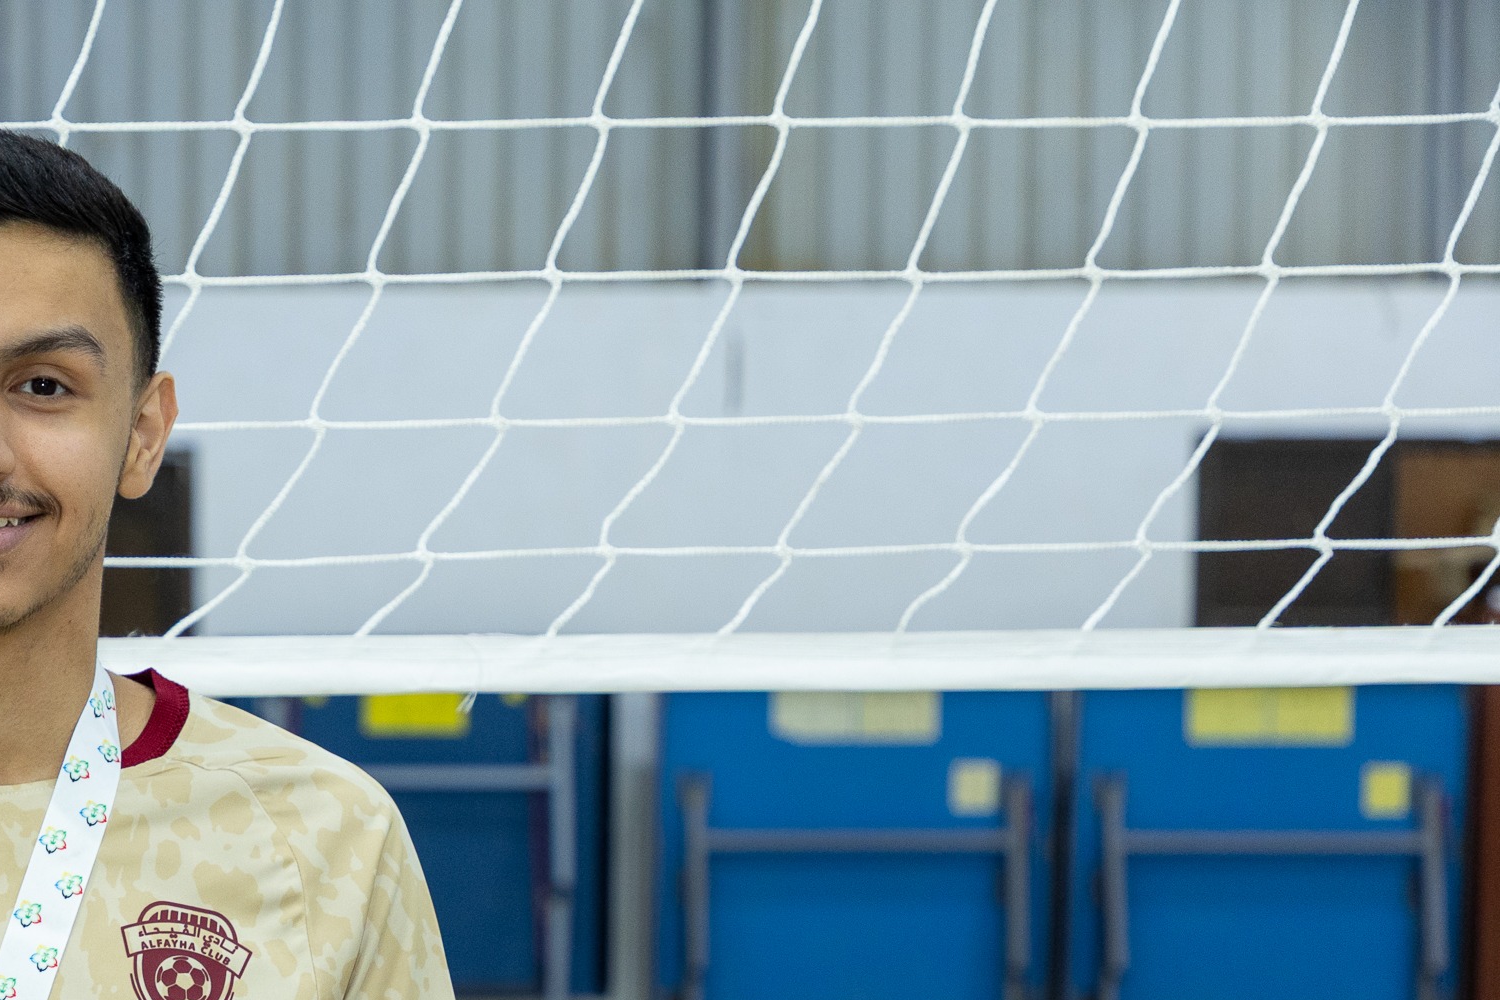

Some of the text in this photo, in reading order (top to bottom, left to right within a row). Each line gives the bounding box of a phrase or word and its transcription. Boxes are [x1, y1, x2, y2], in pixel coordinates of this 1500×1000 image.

[139, 923, 200, 938] الفيحاء
[141, 938, 231, 965] ALFAYHA CLUB
